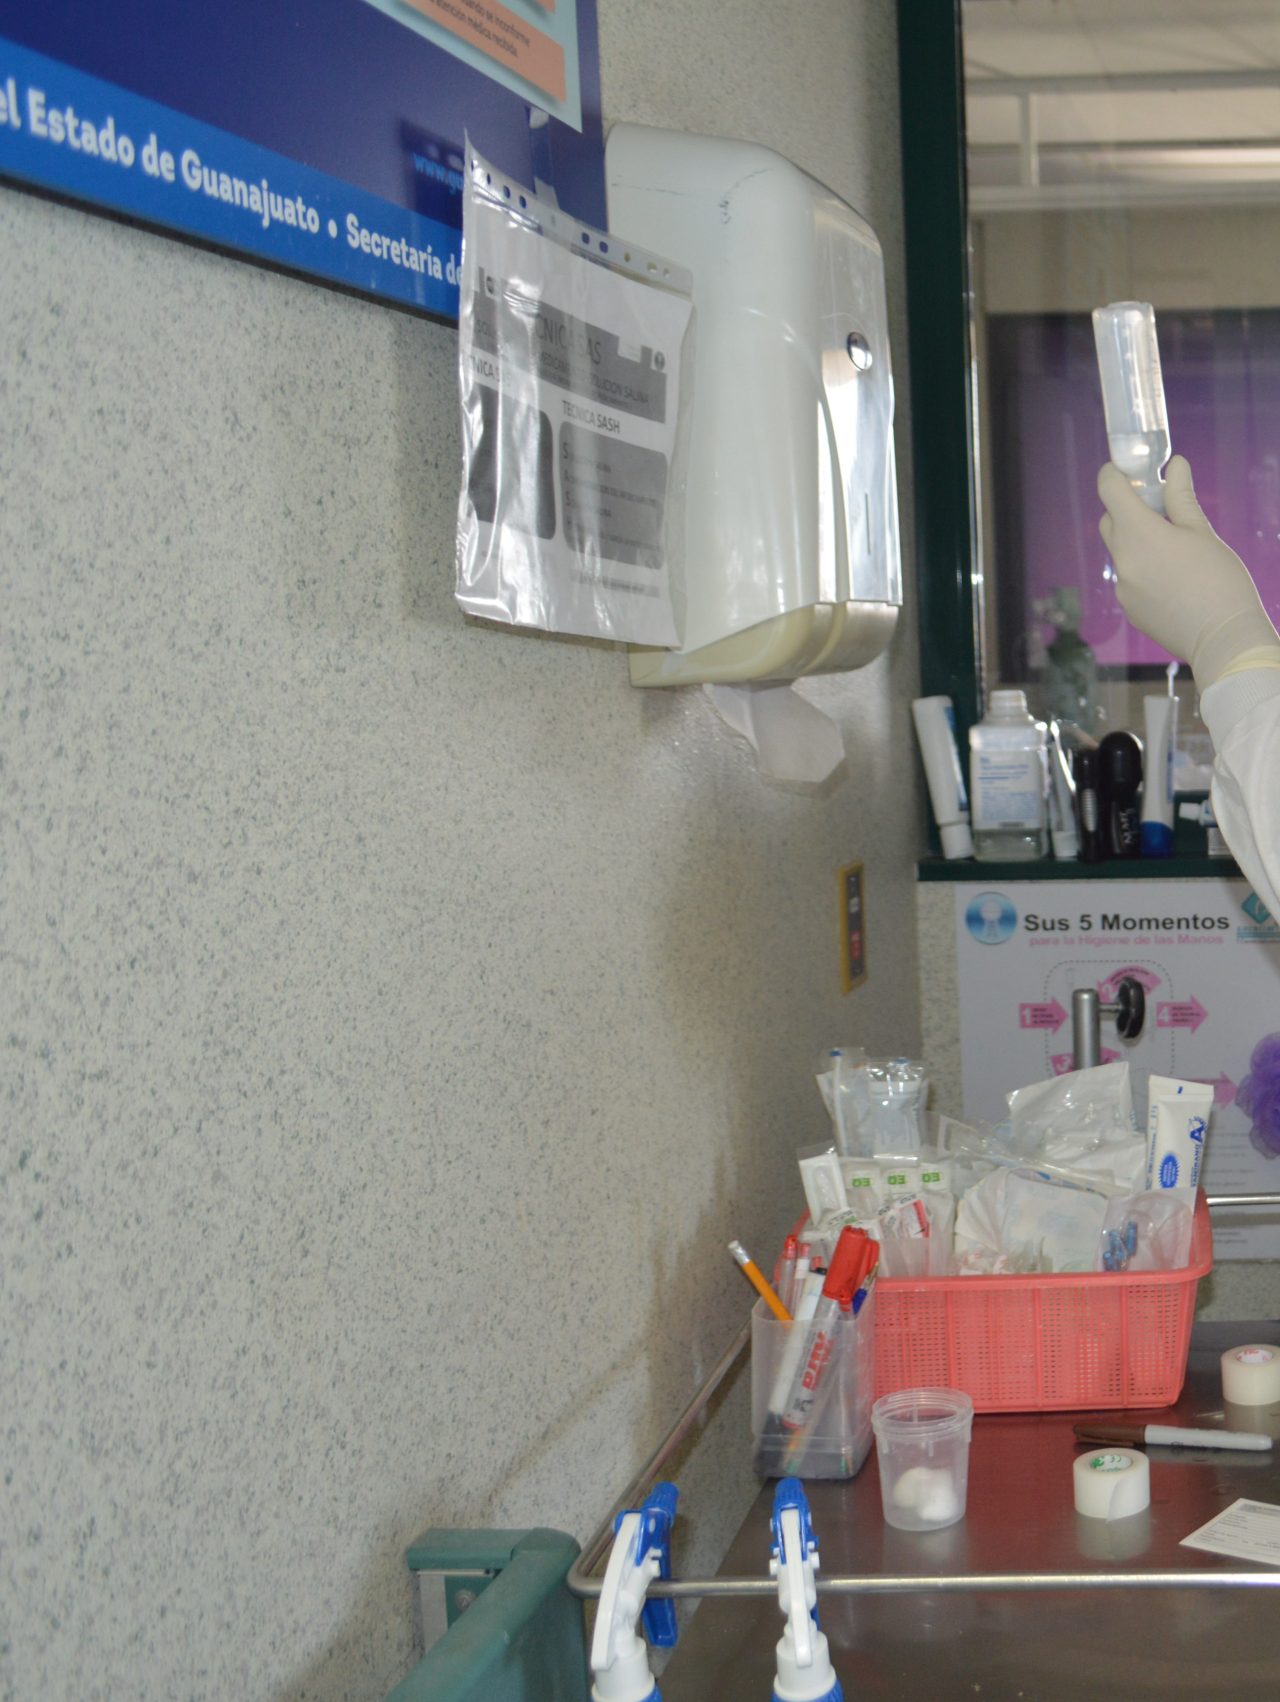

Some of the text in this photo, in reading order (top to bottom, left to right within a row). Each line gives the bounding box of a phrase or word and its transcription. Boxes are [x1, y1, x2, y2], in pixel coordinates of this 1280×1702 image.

[28, 87, 135, 168] Estado
[142, 132, 176, 183] de
[181, 148, 320, 235] Guanajuato
[597, 413, 621, 435] SASH
[1024, 912, 1230, 931] Sus 5 Momentos
[1079, 933, 1130, 948] Higiene
[1134, 933, 1150, 945] de
[1154, 932, 1174, 945] las
[1177, 932, 1224, 945] Manos
